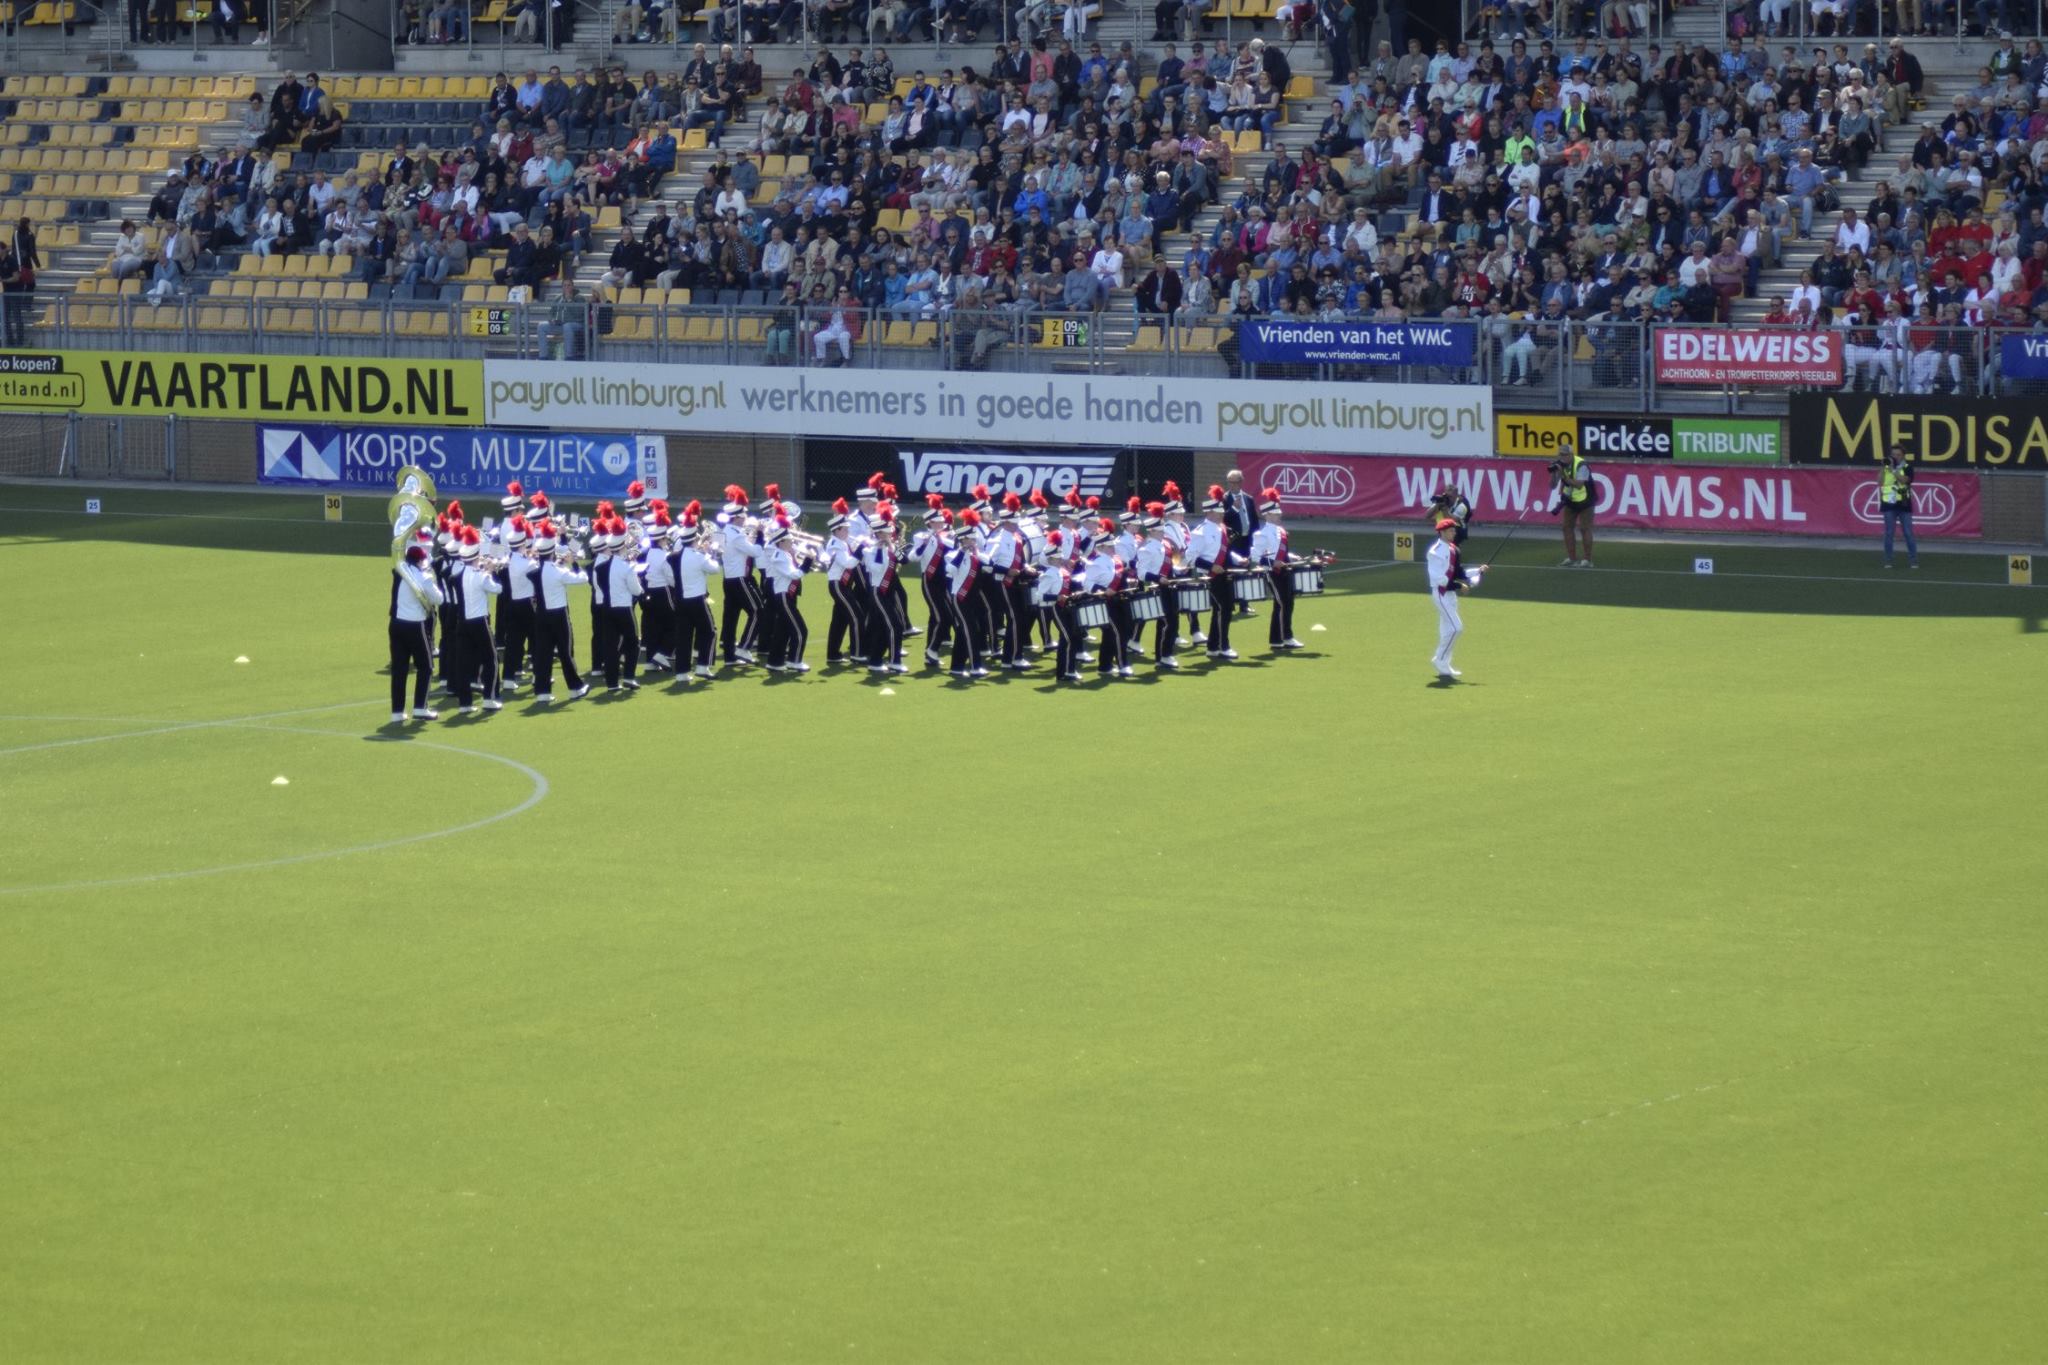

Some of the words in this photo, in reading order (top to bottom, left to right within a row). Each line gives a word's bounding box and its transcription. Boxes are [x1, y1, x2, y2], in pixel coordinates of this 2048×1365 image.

[490, 311, 499, 319] 07
[490, 324, 500, 332] 09
[1064, 321, 1077, 332] 09
[1258, 325, 1335, 344] Vrienden
[1340, 329, 1371, 345] van
[1376, 327, 1404, 346] het
[1409, 327, 1453, 346] WMC
[1067, 335, 1075, 345] 11
[1663, 333, 1831, 364] EDELWEISS
[12, 355, 57, 373] kopen?
[1305, 350, 1400, 361] www.vrienden-wmc.nl
[1661, 368, 1711, 379] JACHTHOORN
[1716, 370, 1726, 379] EN
[1801, 371, 1837, 382] HEERLEN
[100, 359, 468, 416] VAARTLAND.NL
[490, 376, 586, 418] payroll
[592, 376, 726, 416] limburg.nl
[740, 375, 927, 415] werknemers
[938, 382, 965, 416] in
[976, 382, 1073, 428] goede
[1085, 382, 1203, 424] handen
[1217, 397, 1326, 441] payroll
[1332, 398, 1485, 440] limburg.nl
[1506, 424, 1573, 449] Theo
[1584, 425, 1671, 453] Pickée
[1820, 397, 2048, 464] MEDISA
[1678, 431, 1777, 455] TRIBUNE
[345, 433, 447, 469] KORPS
[471, 437, 597, 474] MUZIEK
[610, 452, 623, 465] nl
[346, 470, 397, 482] KLINK
[427, 472, 467, 485] OALS
[476, 473, 500, 487] JIJ
[552, 476, 590, 489] WILT
[899, 452, 1079, 497] Vancore
[1272, 467, 1347, 494] ADAMS
[89, 501, 98, 510] 25
[327, 498, 340, 509] 30
[1396, 536, 1412, 548] 50
[1698, 561, 1710, 570] 45
[2011, 559, 2029, 571] 40
